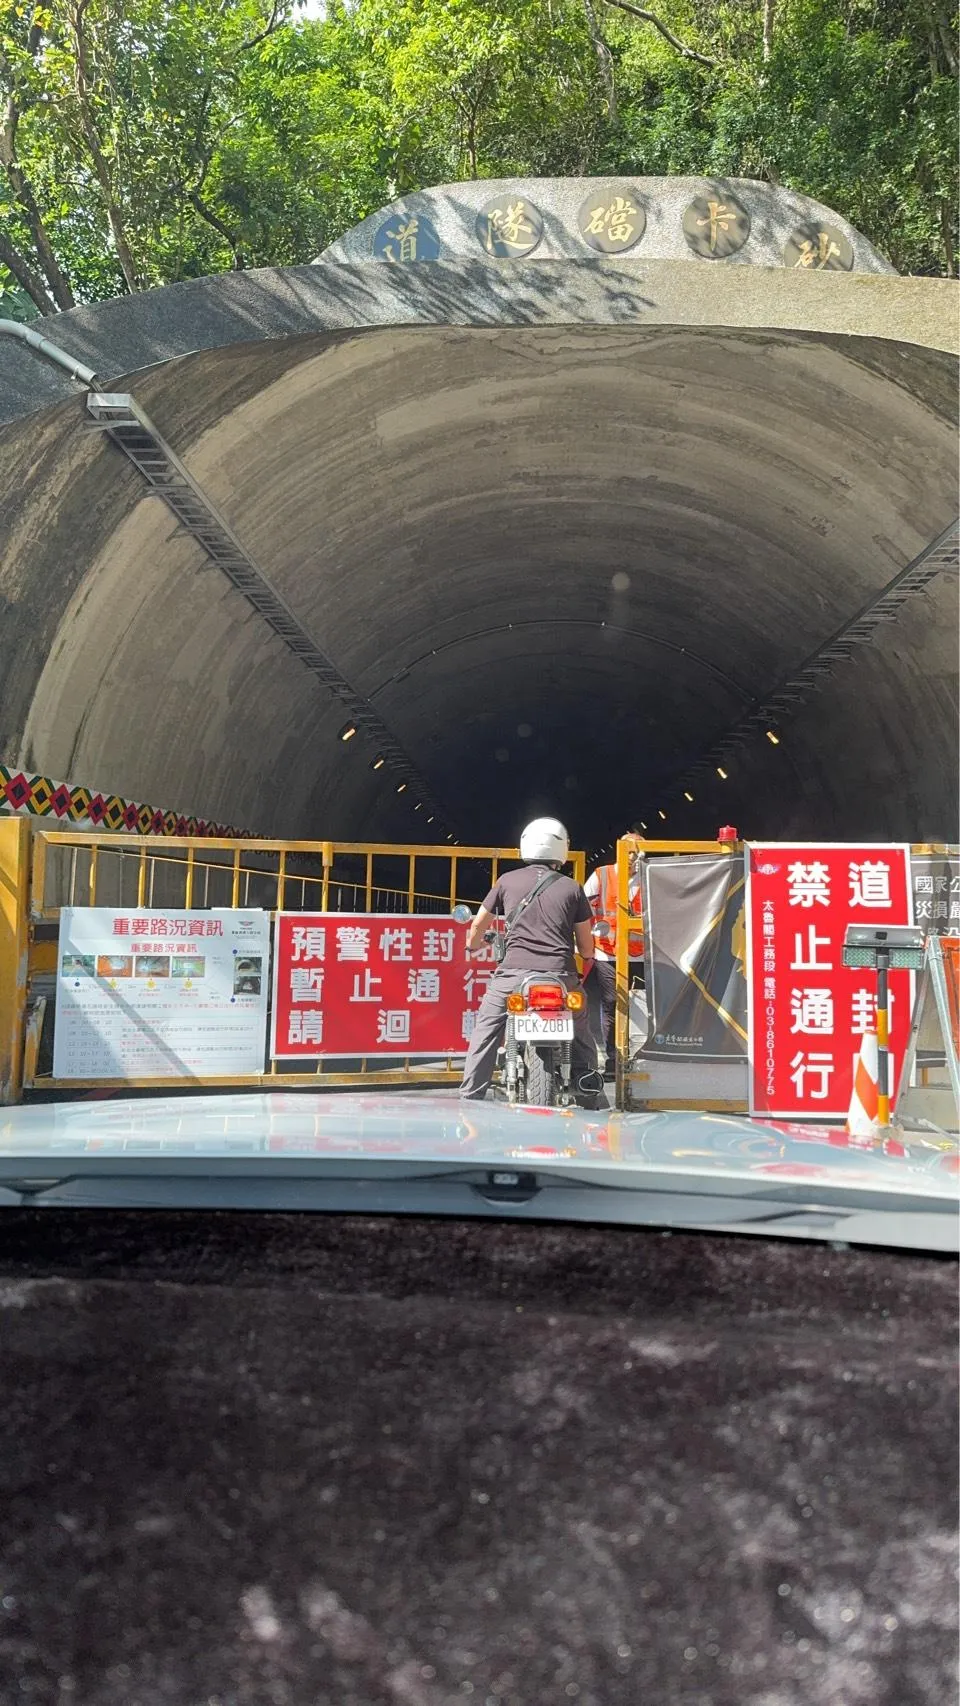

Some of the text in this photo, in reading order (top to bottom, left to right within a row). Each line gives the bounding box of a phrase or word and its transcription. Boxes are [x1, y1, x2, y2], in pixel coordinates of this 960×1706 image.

[112, 917, 224, 937] 重要路況資訊
[131, 943, 198, 953] 重要路況資訊
[289, 967, 492, 1003] 暫止通行
[786, 860, 835, 1099] 禁止通行
